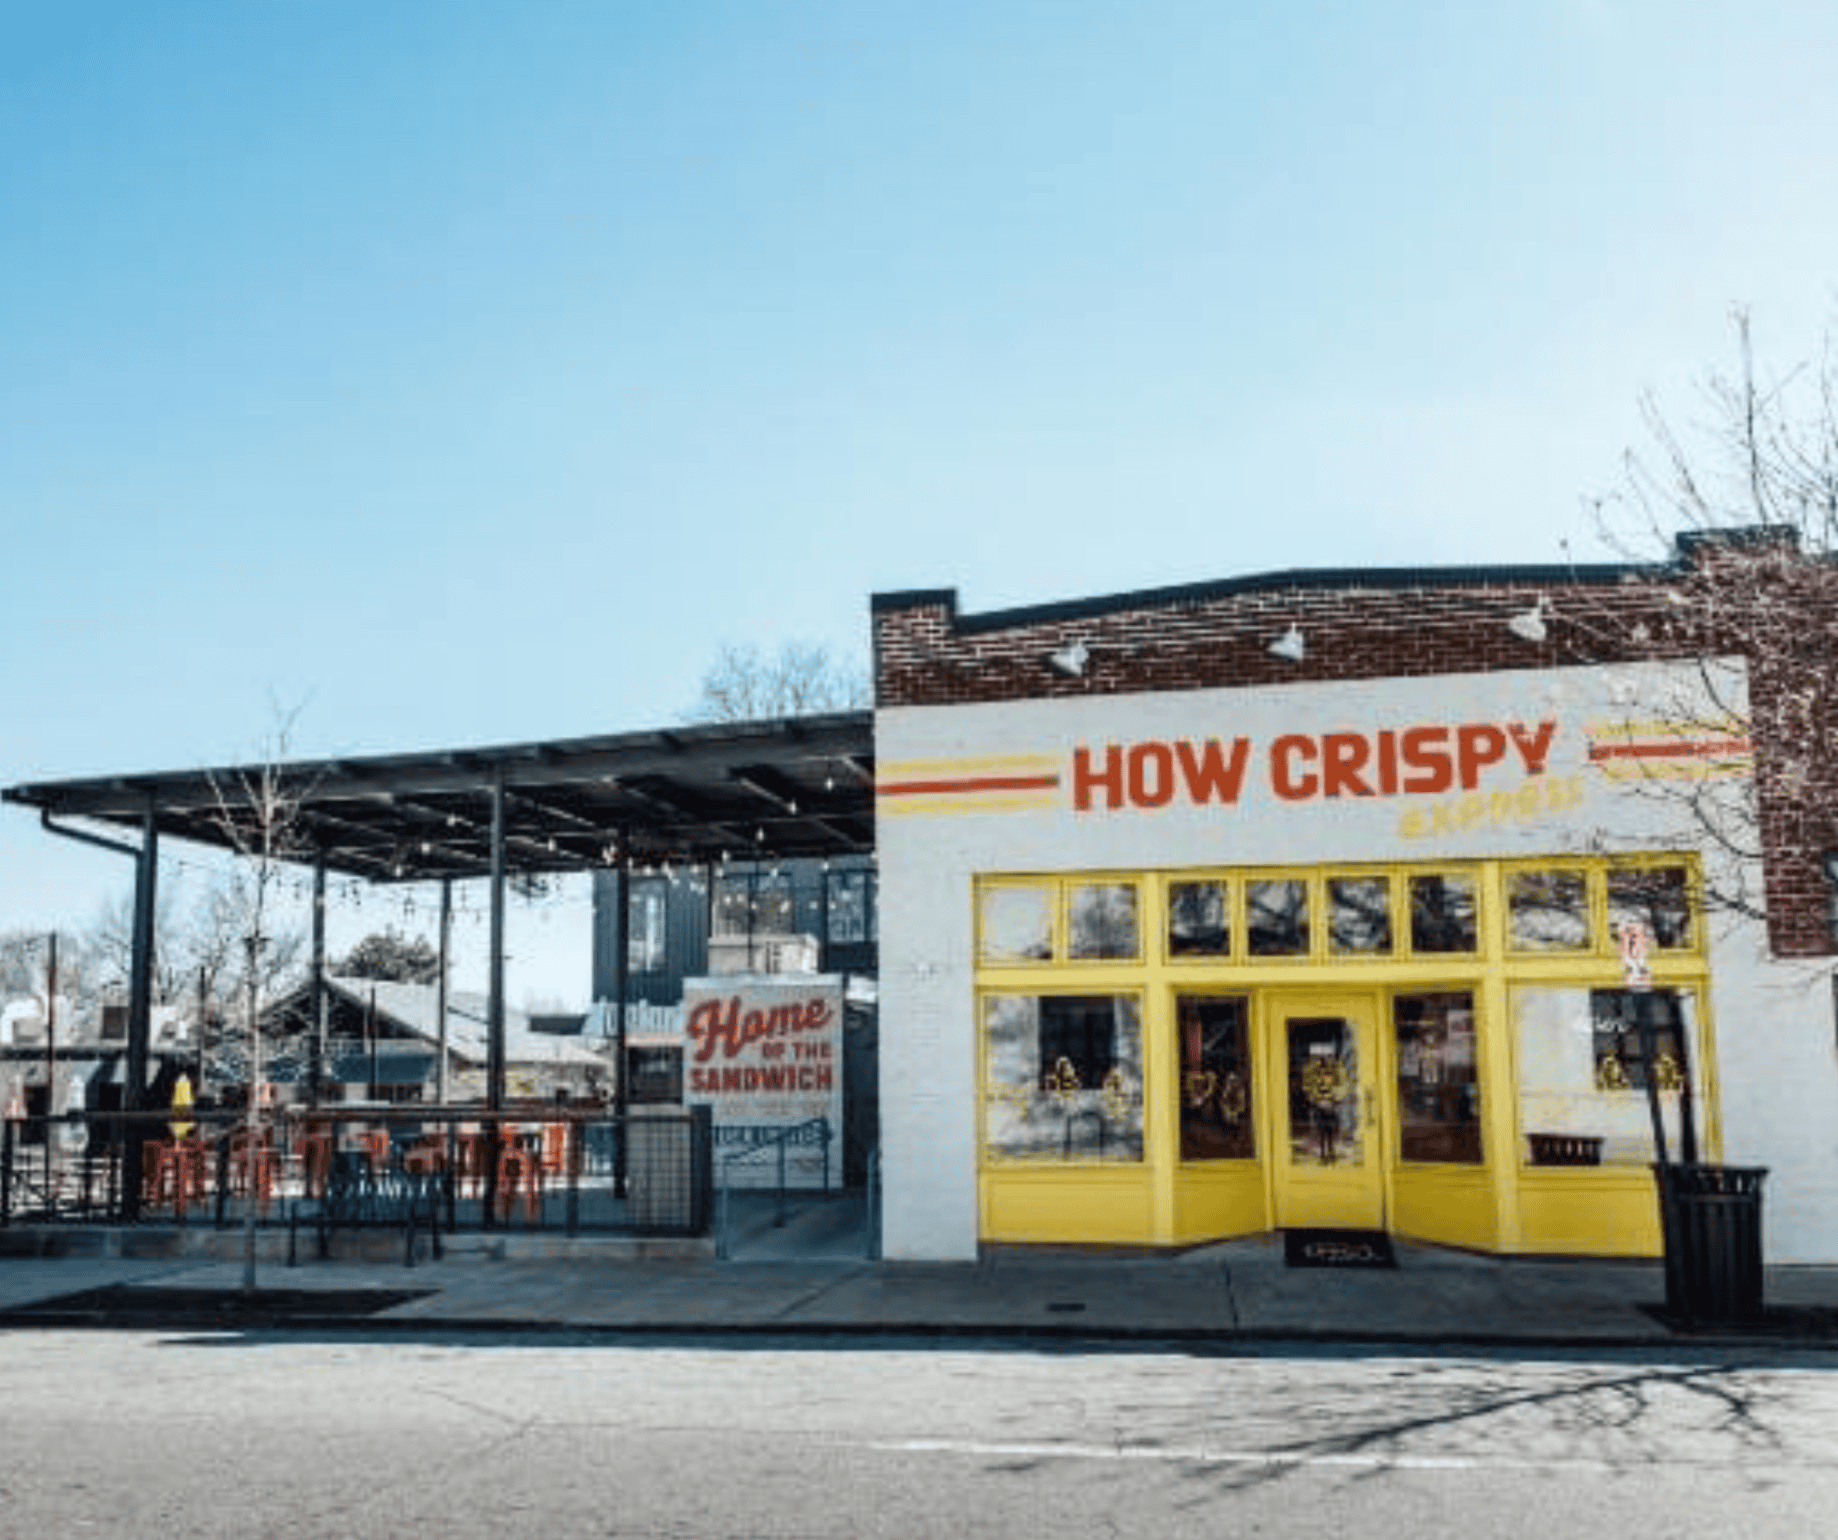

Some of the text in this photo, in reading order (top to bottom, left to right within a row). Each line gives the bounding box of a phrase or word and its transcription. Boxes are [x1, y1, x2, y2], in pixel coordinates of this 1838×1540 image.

[1072, 720, 1557, 811] HOW CRISPY
[686, 995, 832, 1062] Home
[792, 1042, 832, 1059] THE
[690, 1065, 833, 1091] SANDWICH
